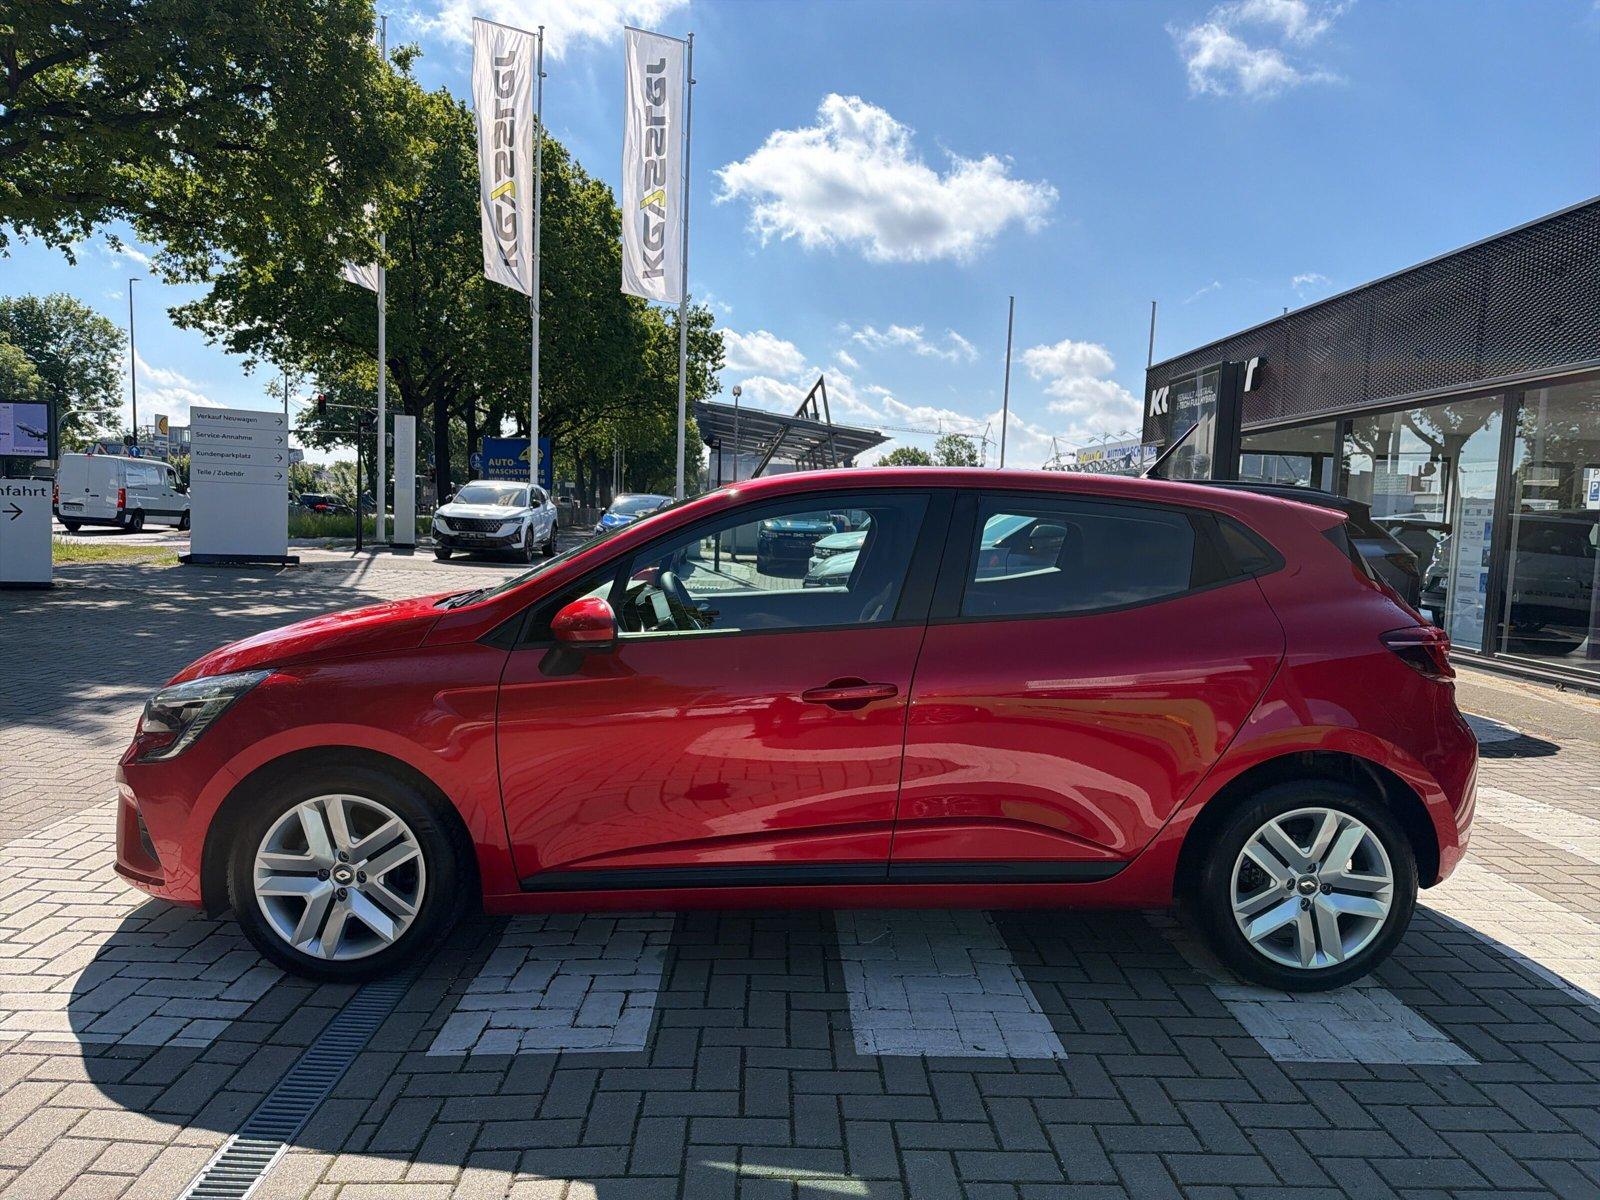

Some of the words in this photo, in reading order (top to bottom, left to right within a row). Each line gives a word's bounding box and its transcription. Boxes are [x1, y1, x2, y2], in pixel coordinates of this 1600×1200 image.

[224, 415, 257, 424] Neuwagen
[195, 431, 253, 441] Service-Annahme
[196, 450, 251, 460] Kundenparkplatz
[217, 469, 246, 477] Zubehör
